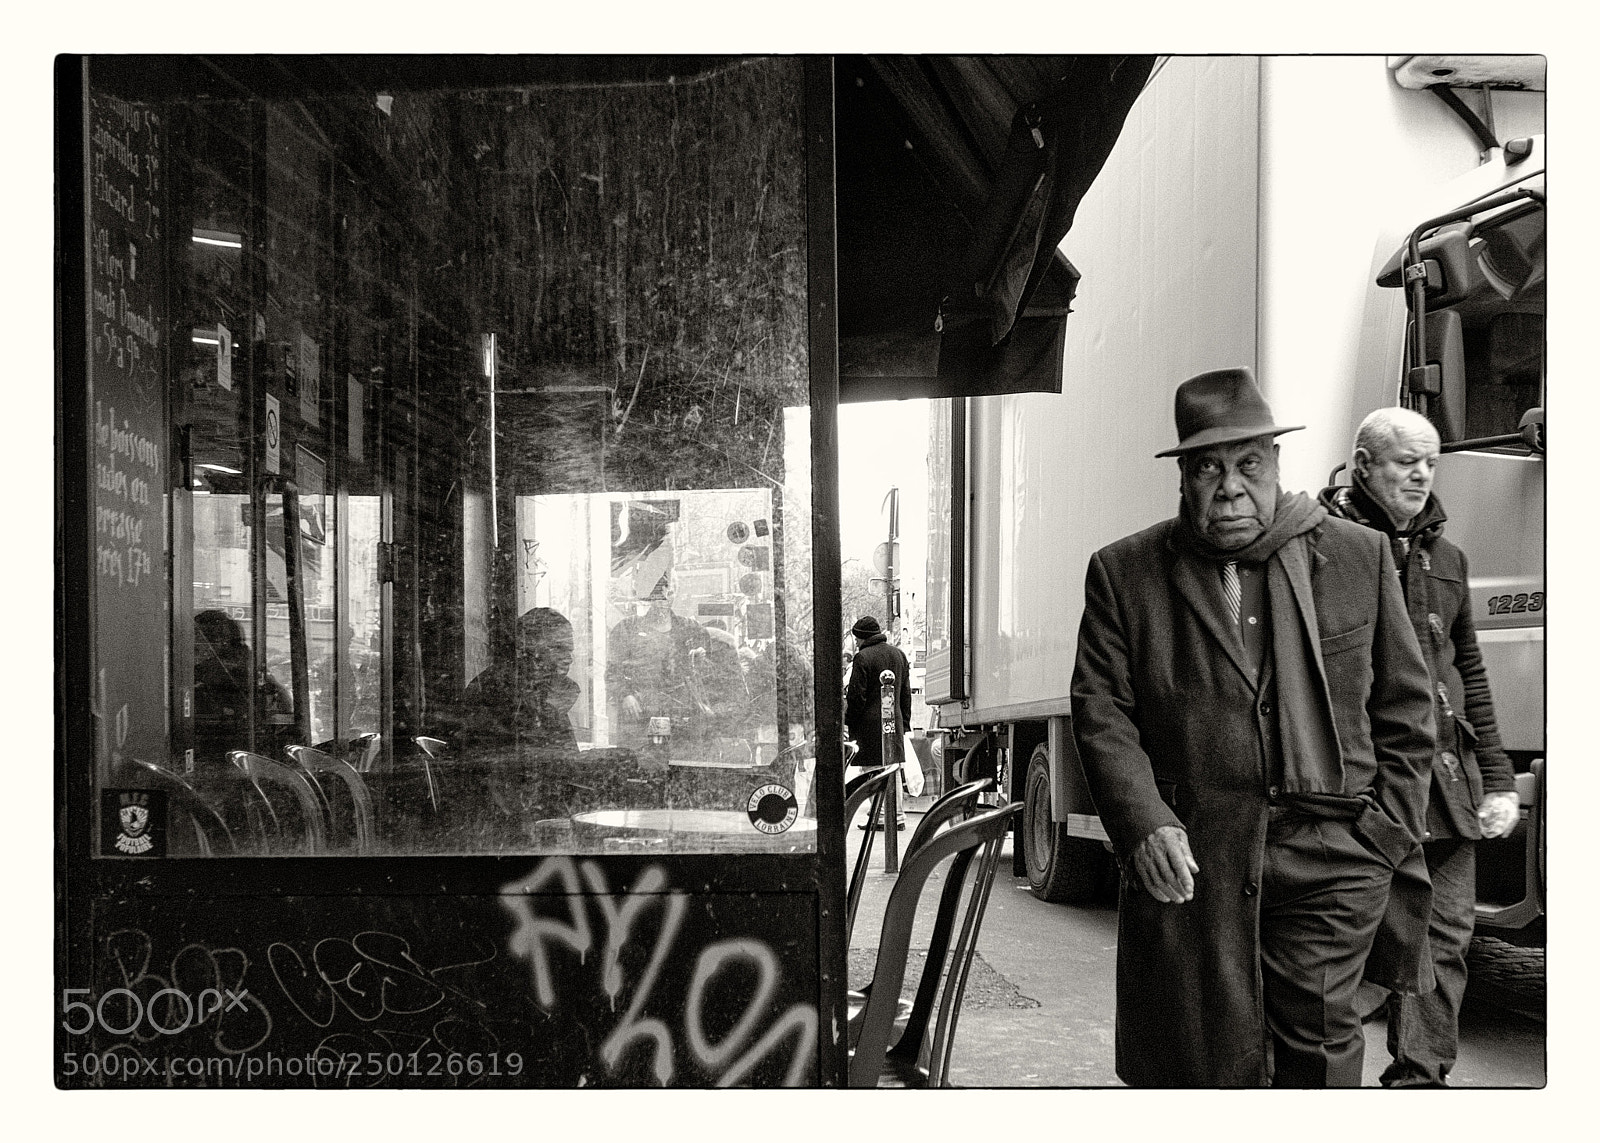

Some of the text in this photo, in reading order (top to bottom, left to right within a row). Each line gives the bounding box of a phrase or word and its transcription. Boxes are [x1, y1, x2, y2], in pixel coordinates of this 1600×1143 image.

[1487, 591, 1544, 615] 1223
[749, 785, 790, 810] VELO CLUB
[756, 809, 796, 833] LORRAINE
